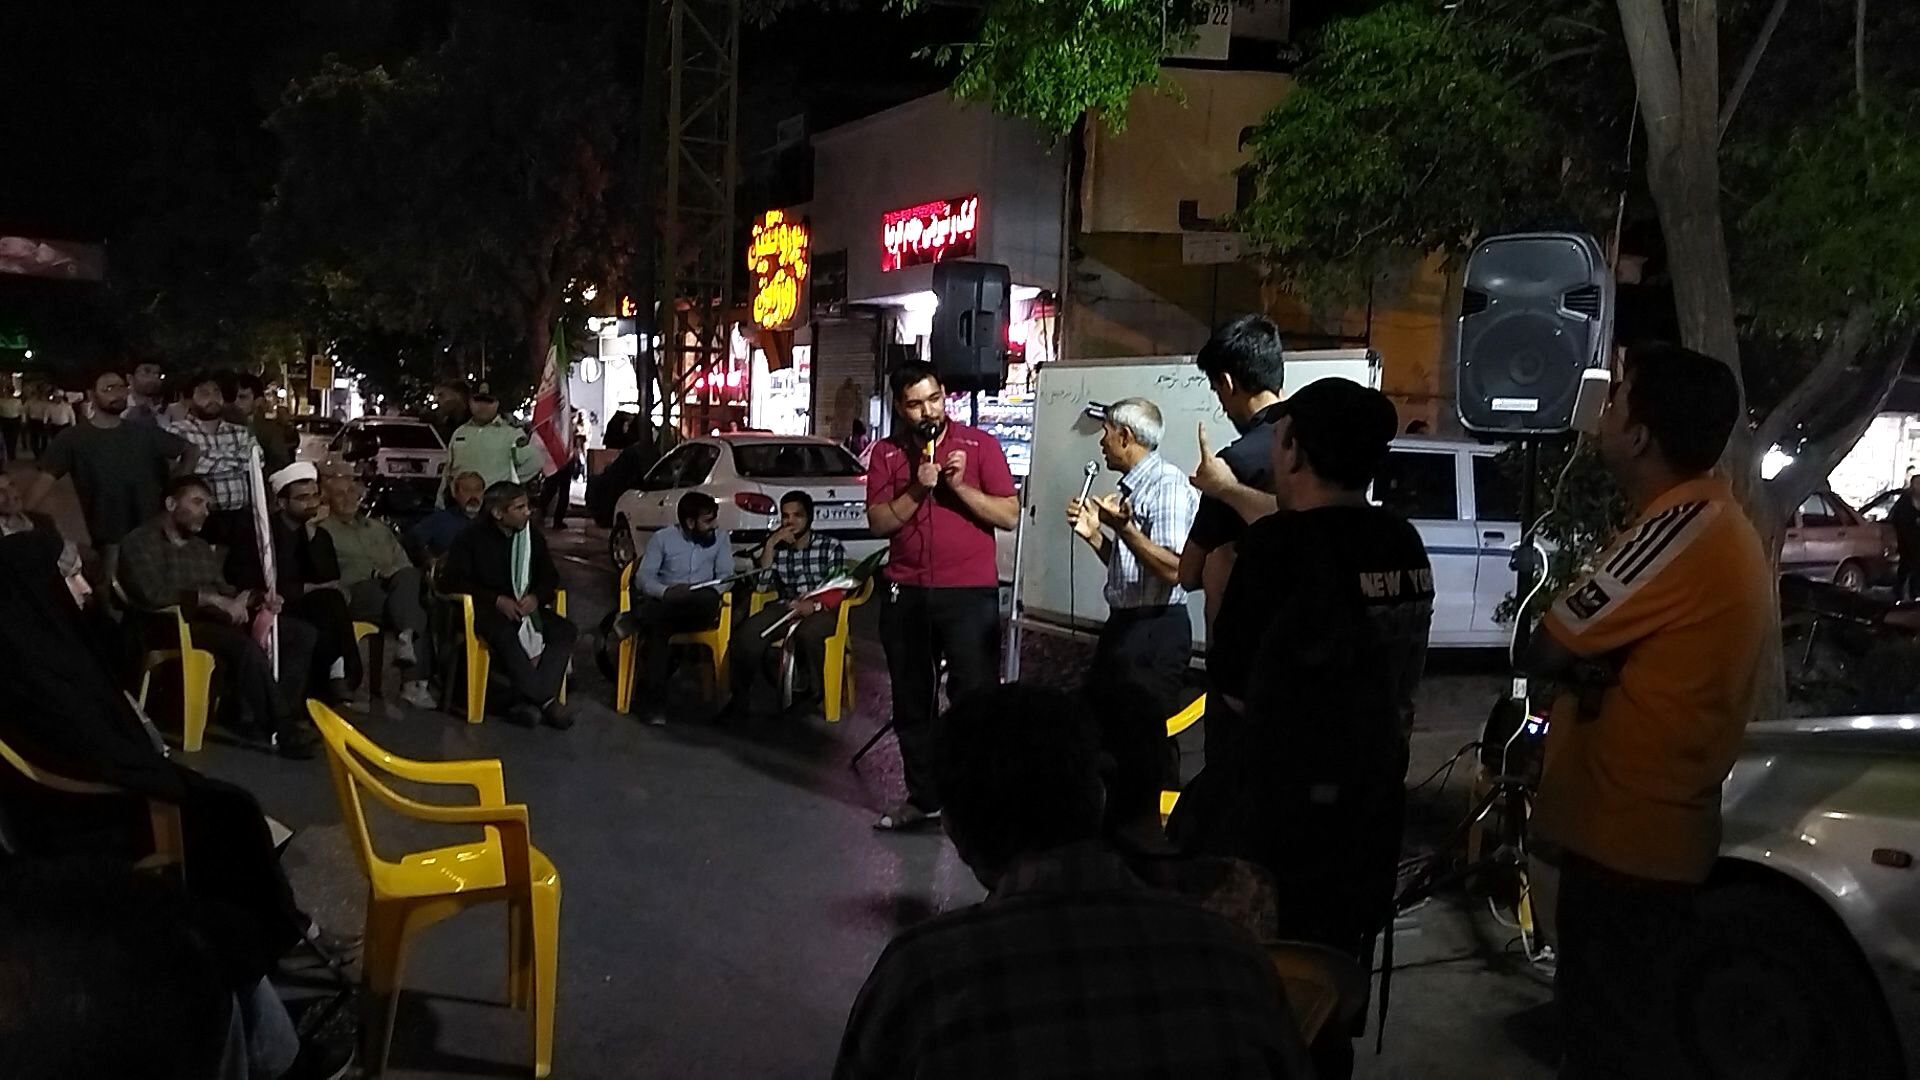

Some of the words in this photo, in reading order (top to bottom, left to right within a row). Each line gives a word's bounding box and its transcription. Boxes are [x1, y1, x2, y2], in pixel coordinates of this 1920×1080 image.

[1212, 3, 1229, 25] 22
[1360, 570, 1401, 597] NEW
[1407, 568, 1433, 594] YO
